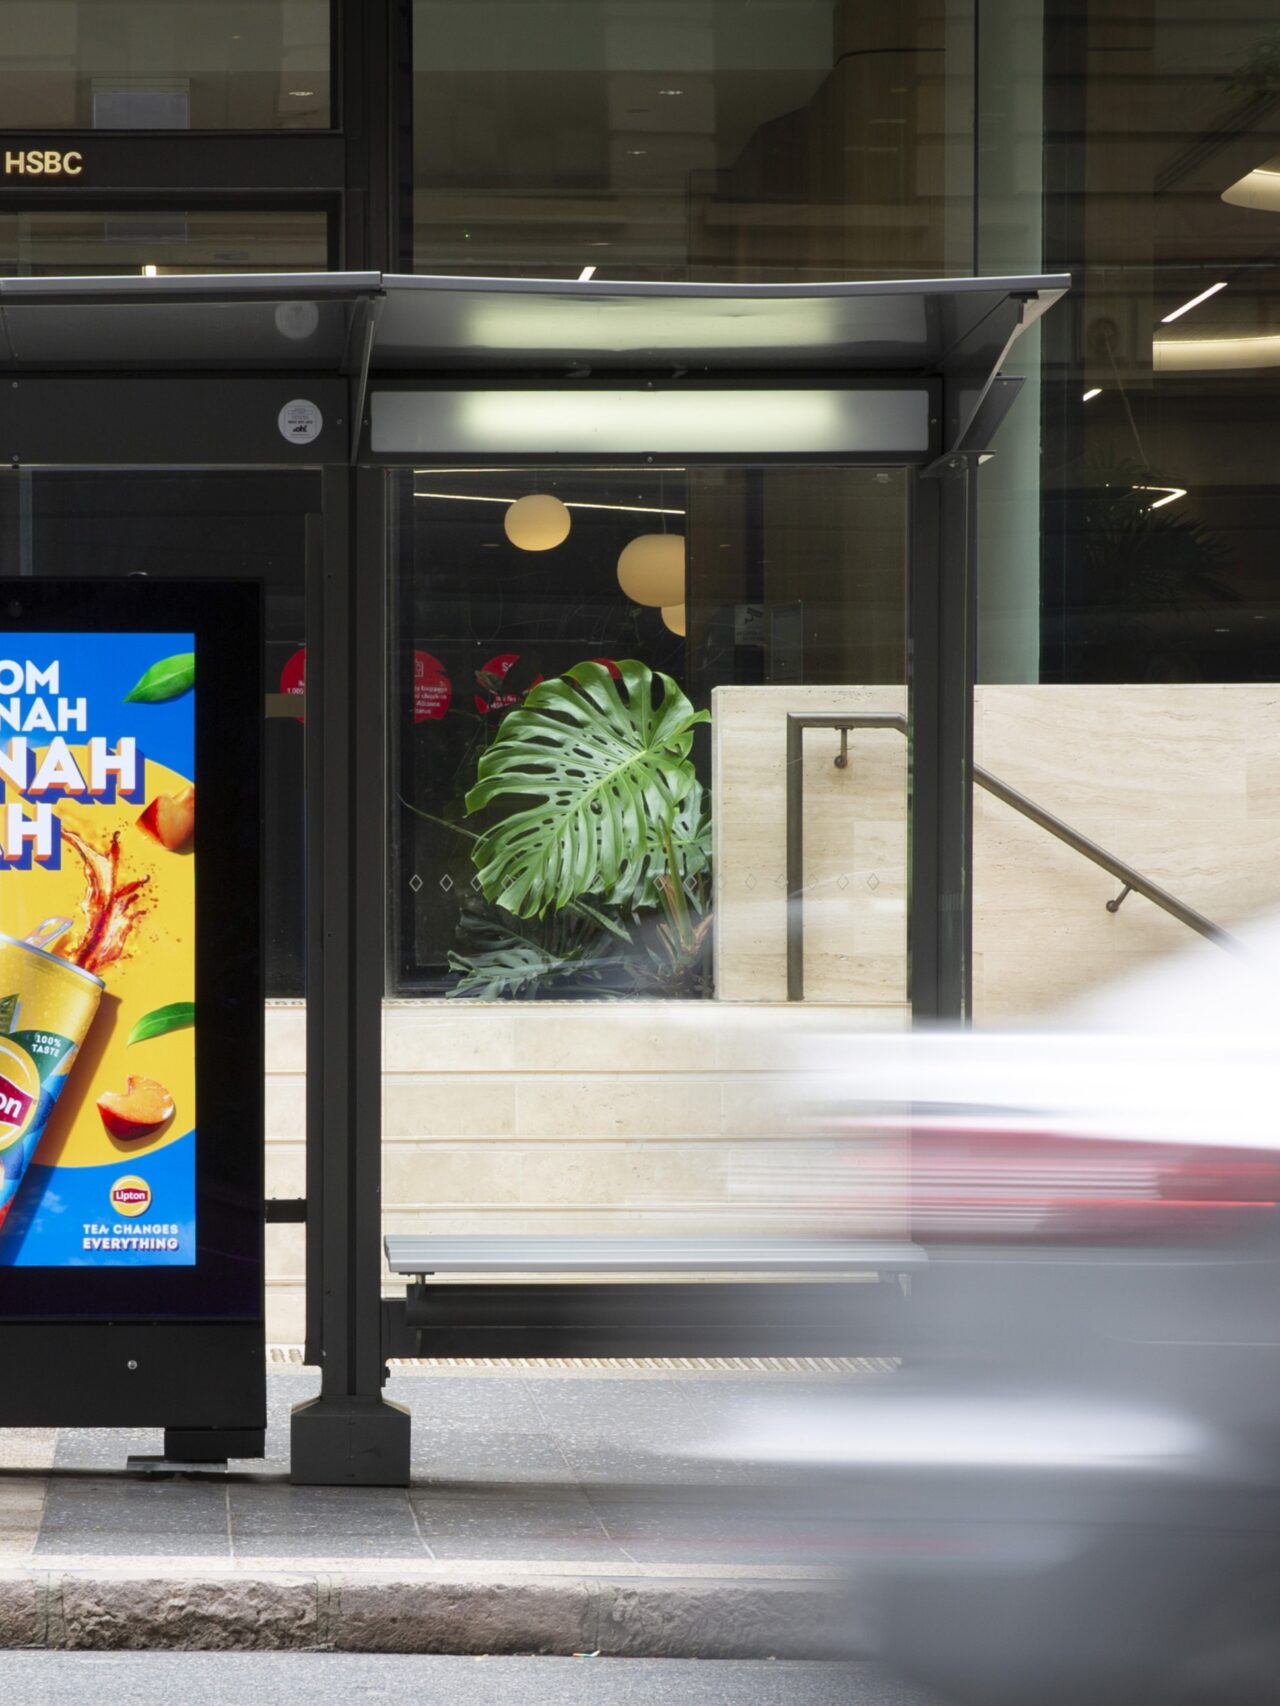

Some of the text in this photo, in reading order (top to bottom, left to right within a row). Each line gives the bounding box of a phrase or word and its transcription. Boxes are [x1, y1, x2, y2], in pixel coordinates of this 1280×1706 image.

[5, 150, 83, 174] HSBC
[35, 1033, 62, 1048] 100%
[31, 1043, 60, 1058] TASTE
[115, 1191, 147, 1202] Lipton
[82, 1223, 180, 1236] TEA CHANGES
[82, 1237, 180, 1251] EVERYTHING
